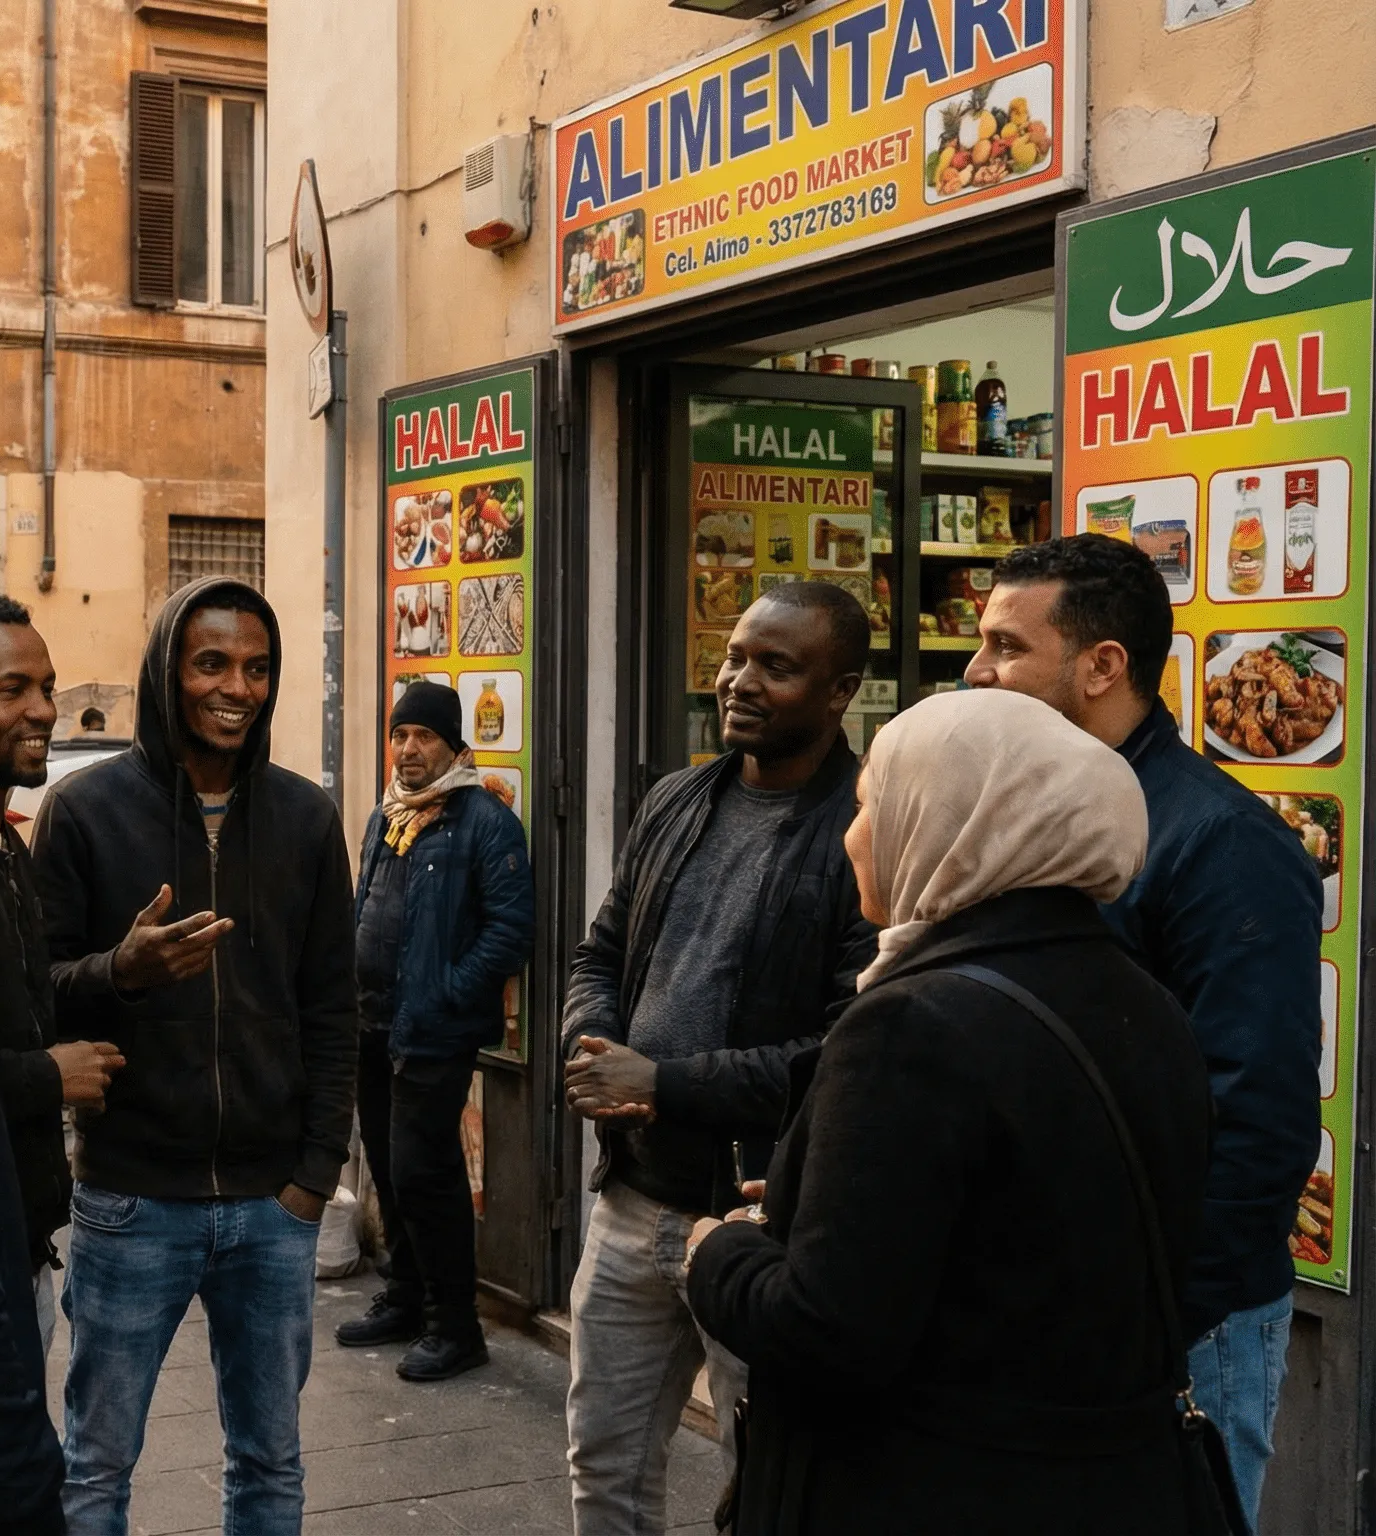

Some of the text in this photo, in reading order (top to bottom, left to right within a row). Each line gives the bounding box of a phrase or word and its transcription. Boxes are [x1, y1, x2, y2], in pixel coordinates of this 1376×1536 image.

[654, 129, 912, 242] ETHNIC FOOD MARKET
[666, 247, 697, 276] Cel.
[768, 182, 897, 246] 3372783169
[1109, 207, 1353, 331] حلال
[395, 391, 524, 472] HALAL
[1082, 331, 1350, 449] HALAL
[697, 470, 870, 508] ALIMENTARI
[733, 423, 847, 462] HALAL
